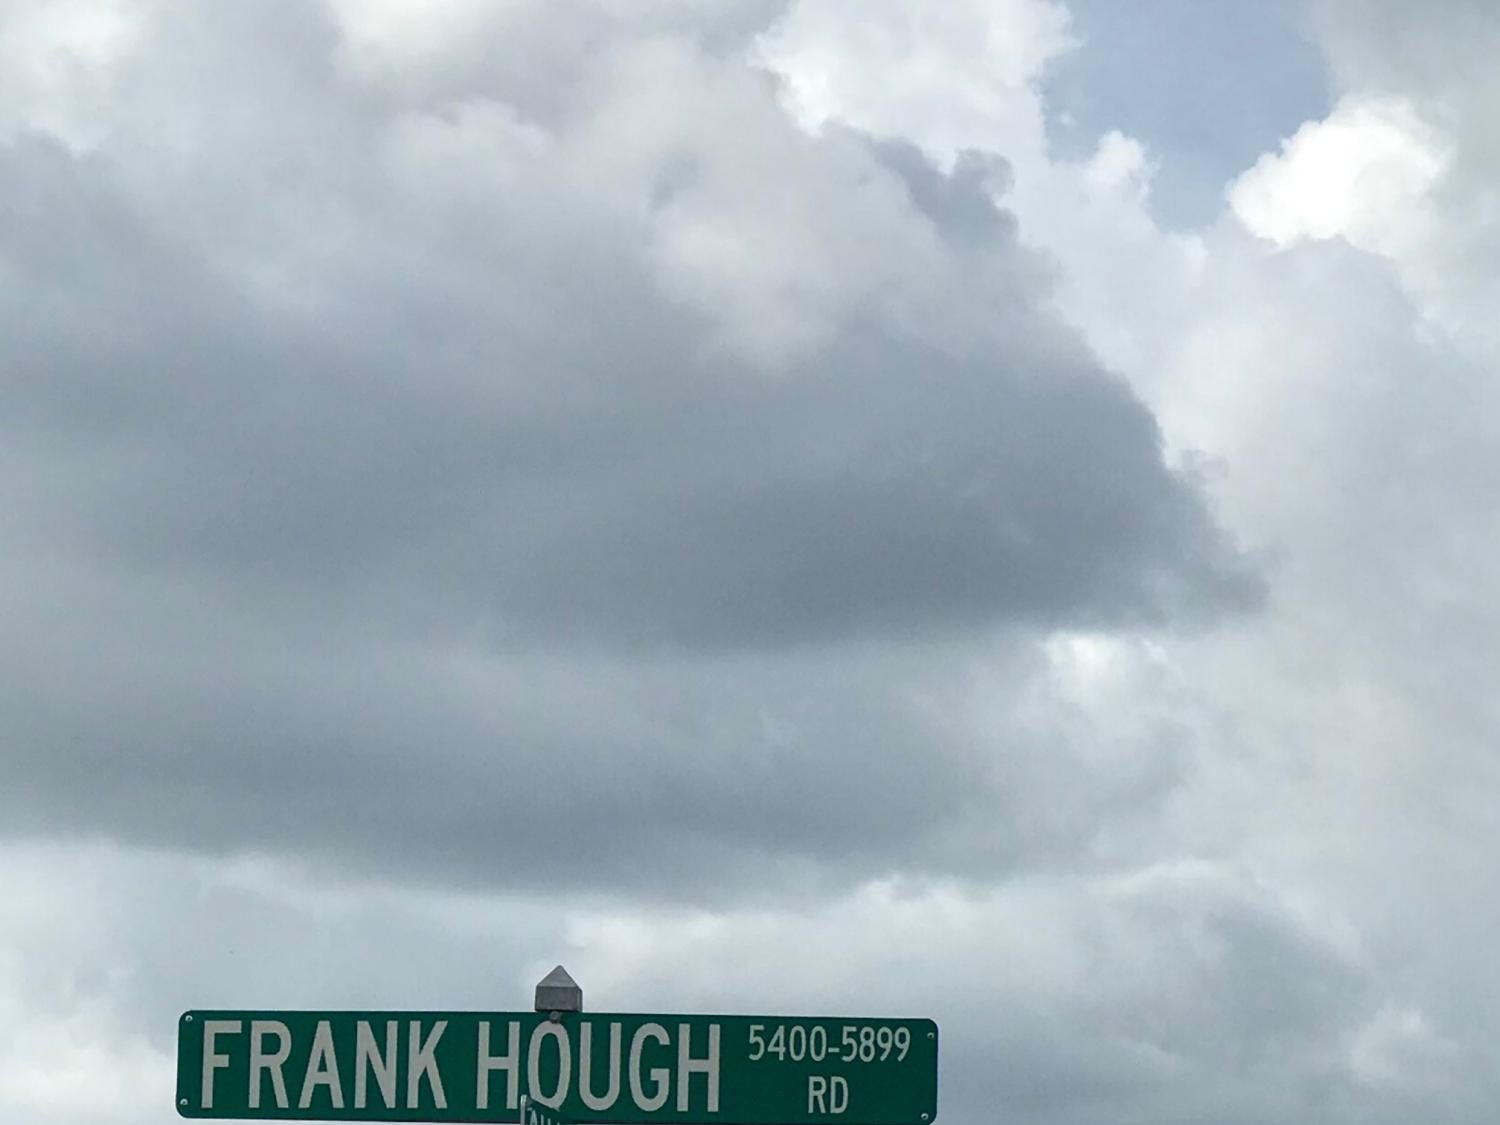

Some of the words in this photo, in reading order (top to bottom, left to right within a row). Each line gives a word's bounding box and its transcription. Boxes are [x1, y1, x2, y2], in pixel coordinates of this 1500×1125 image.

[201, 1020, 448, 1109] FRANK
[476, 1020, 721, 1112] HOUGH
[749, 1024, 911, 1062] 5400-5899
[807, 1075, 849, 1114] RD
